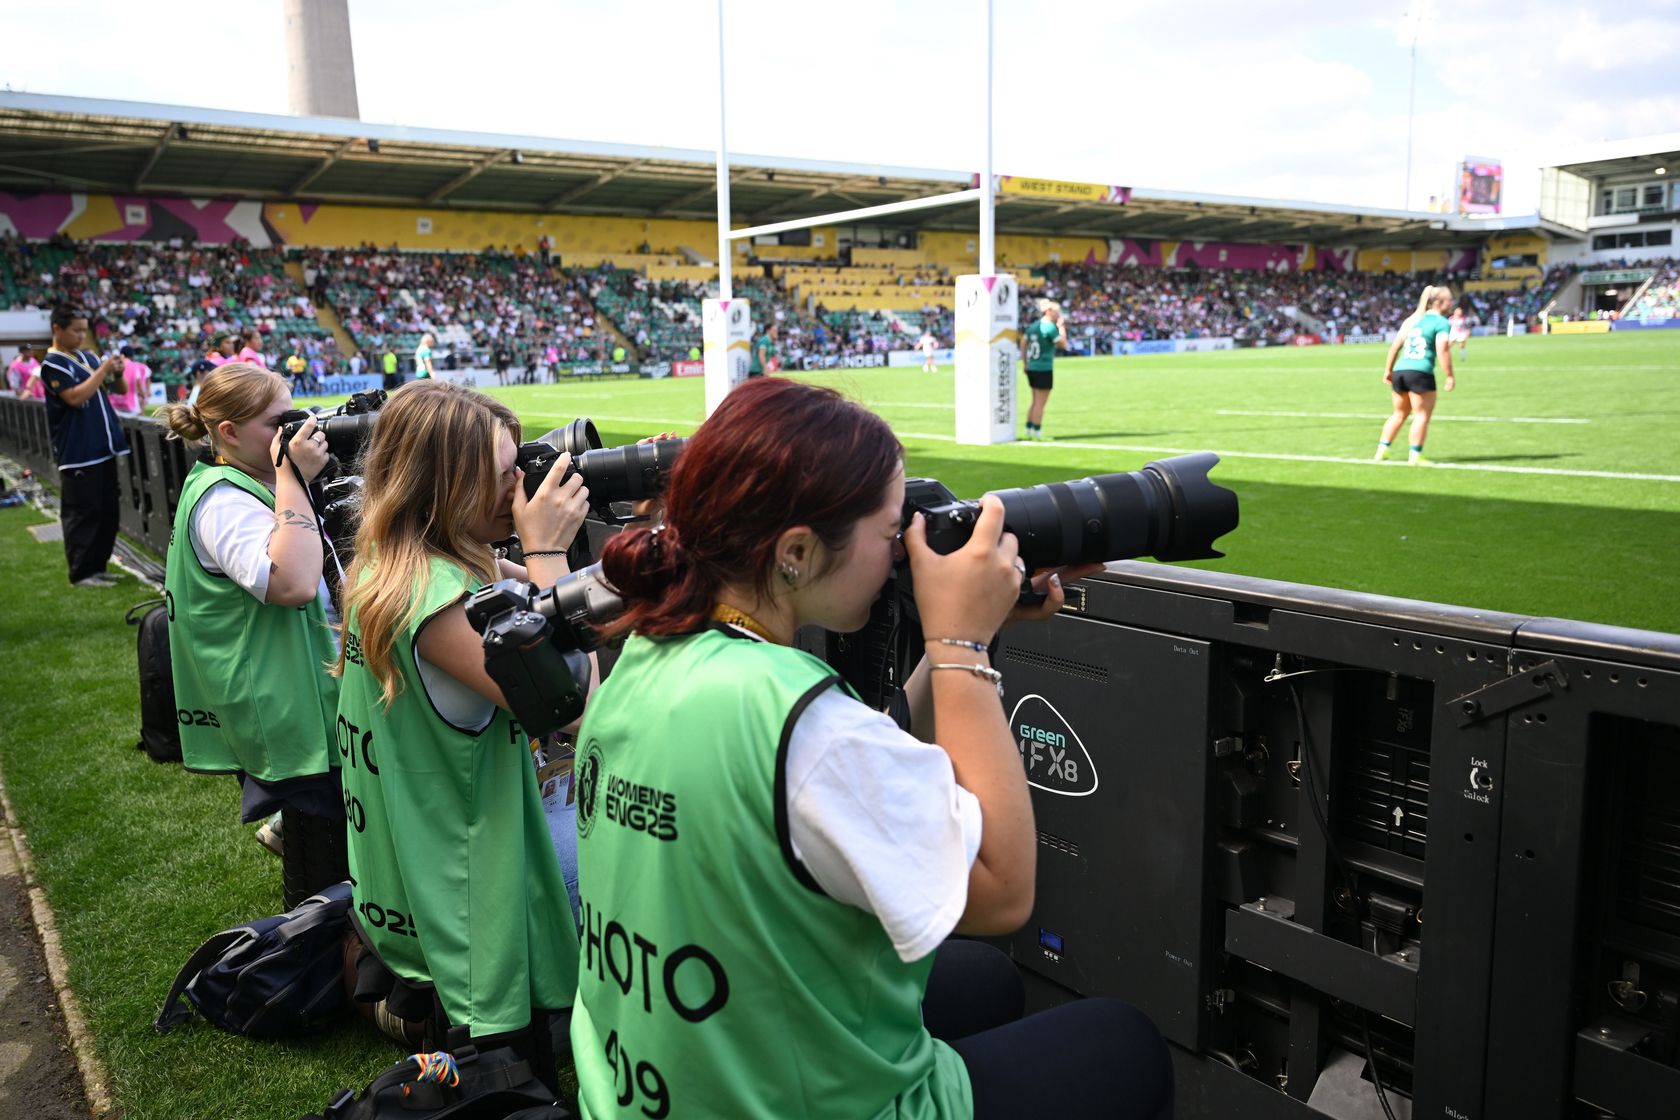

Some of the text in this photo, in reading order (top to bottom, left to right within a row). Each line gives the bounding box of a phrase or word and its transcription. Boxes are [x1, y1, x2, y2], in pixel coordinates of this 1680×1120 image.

[1020, 181, 1092, 195] WEST STAND
[177, 709, 221, 729] 025
[1019, 723, 1066, 749] Green
[1471, 756, 1488, 769] Lock
[605, 793, 679, 842] ENG25
